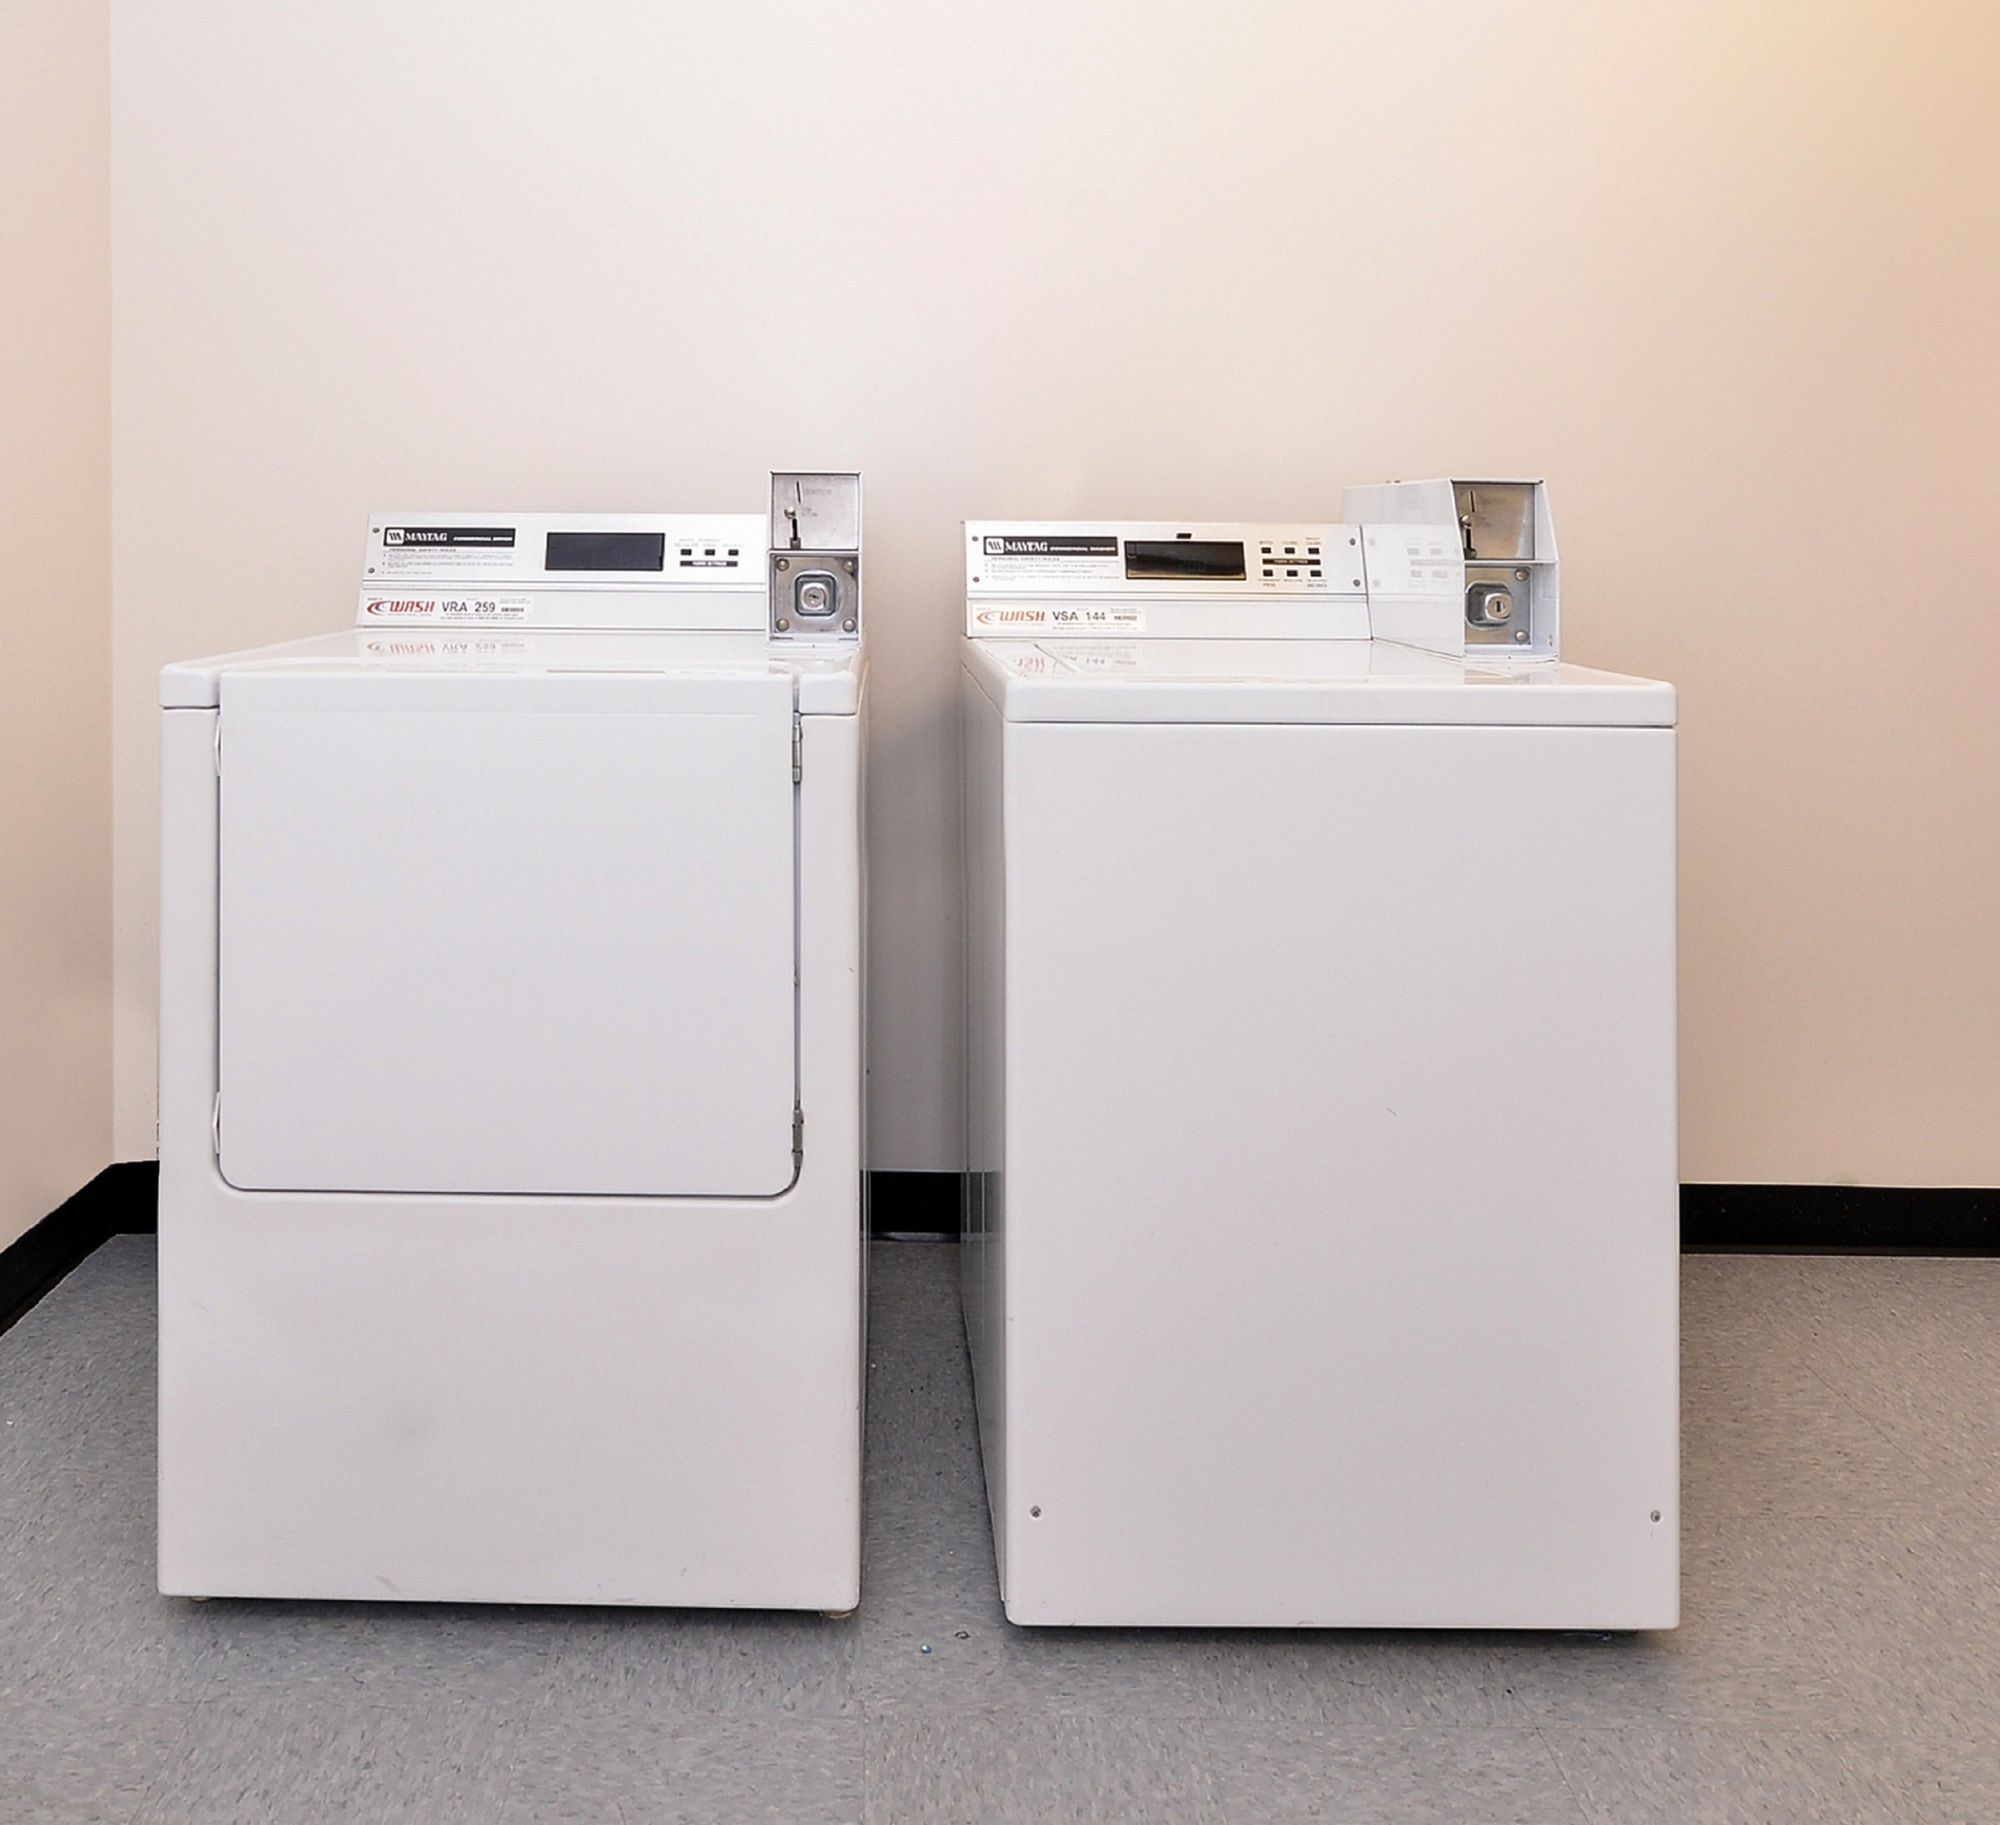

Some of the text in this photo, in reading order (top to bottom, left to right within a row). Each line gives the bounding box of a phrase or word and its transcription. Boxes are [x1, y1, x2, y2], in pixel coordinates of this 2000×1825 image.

[405, 532, 448, 542] MAYTAG
[1005, 541, 1048, 552] MAYTAG
[389, 600, 435, 612] WASH
[442, 600, 468, 613] VRA
[474, 601, 496, 613] 259
[1000, 610, 1045, 622] WASH
[1052, 610, 1079, 621] VSA
[1086, 611, 1106, 621] 144
